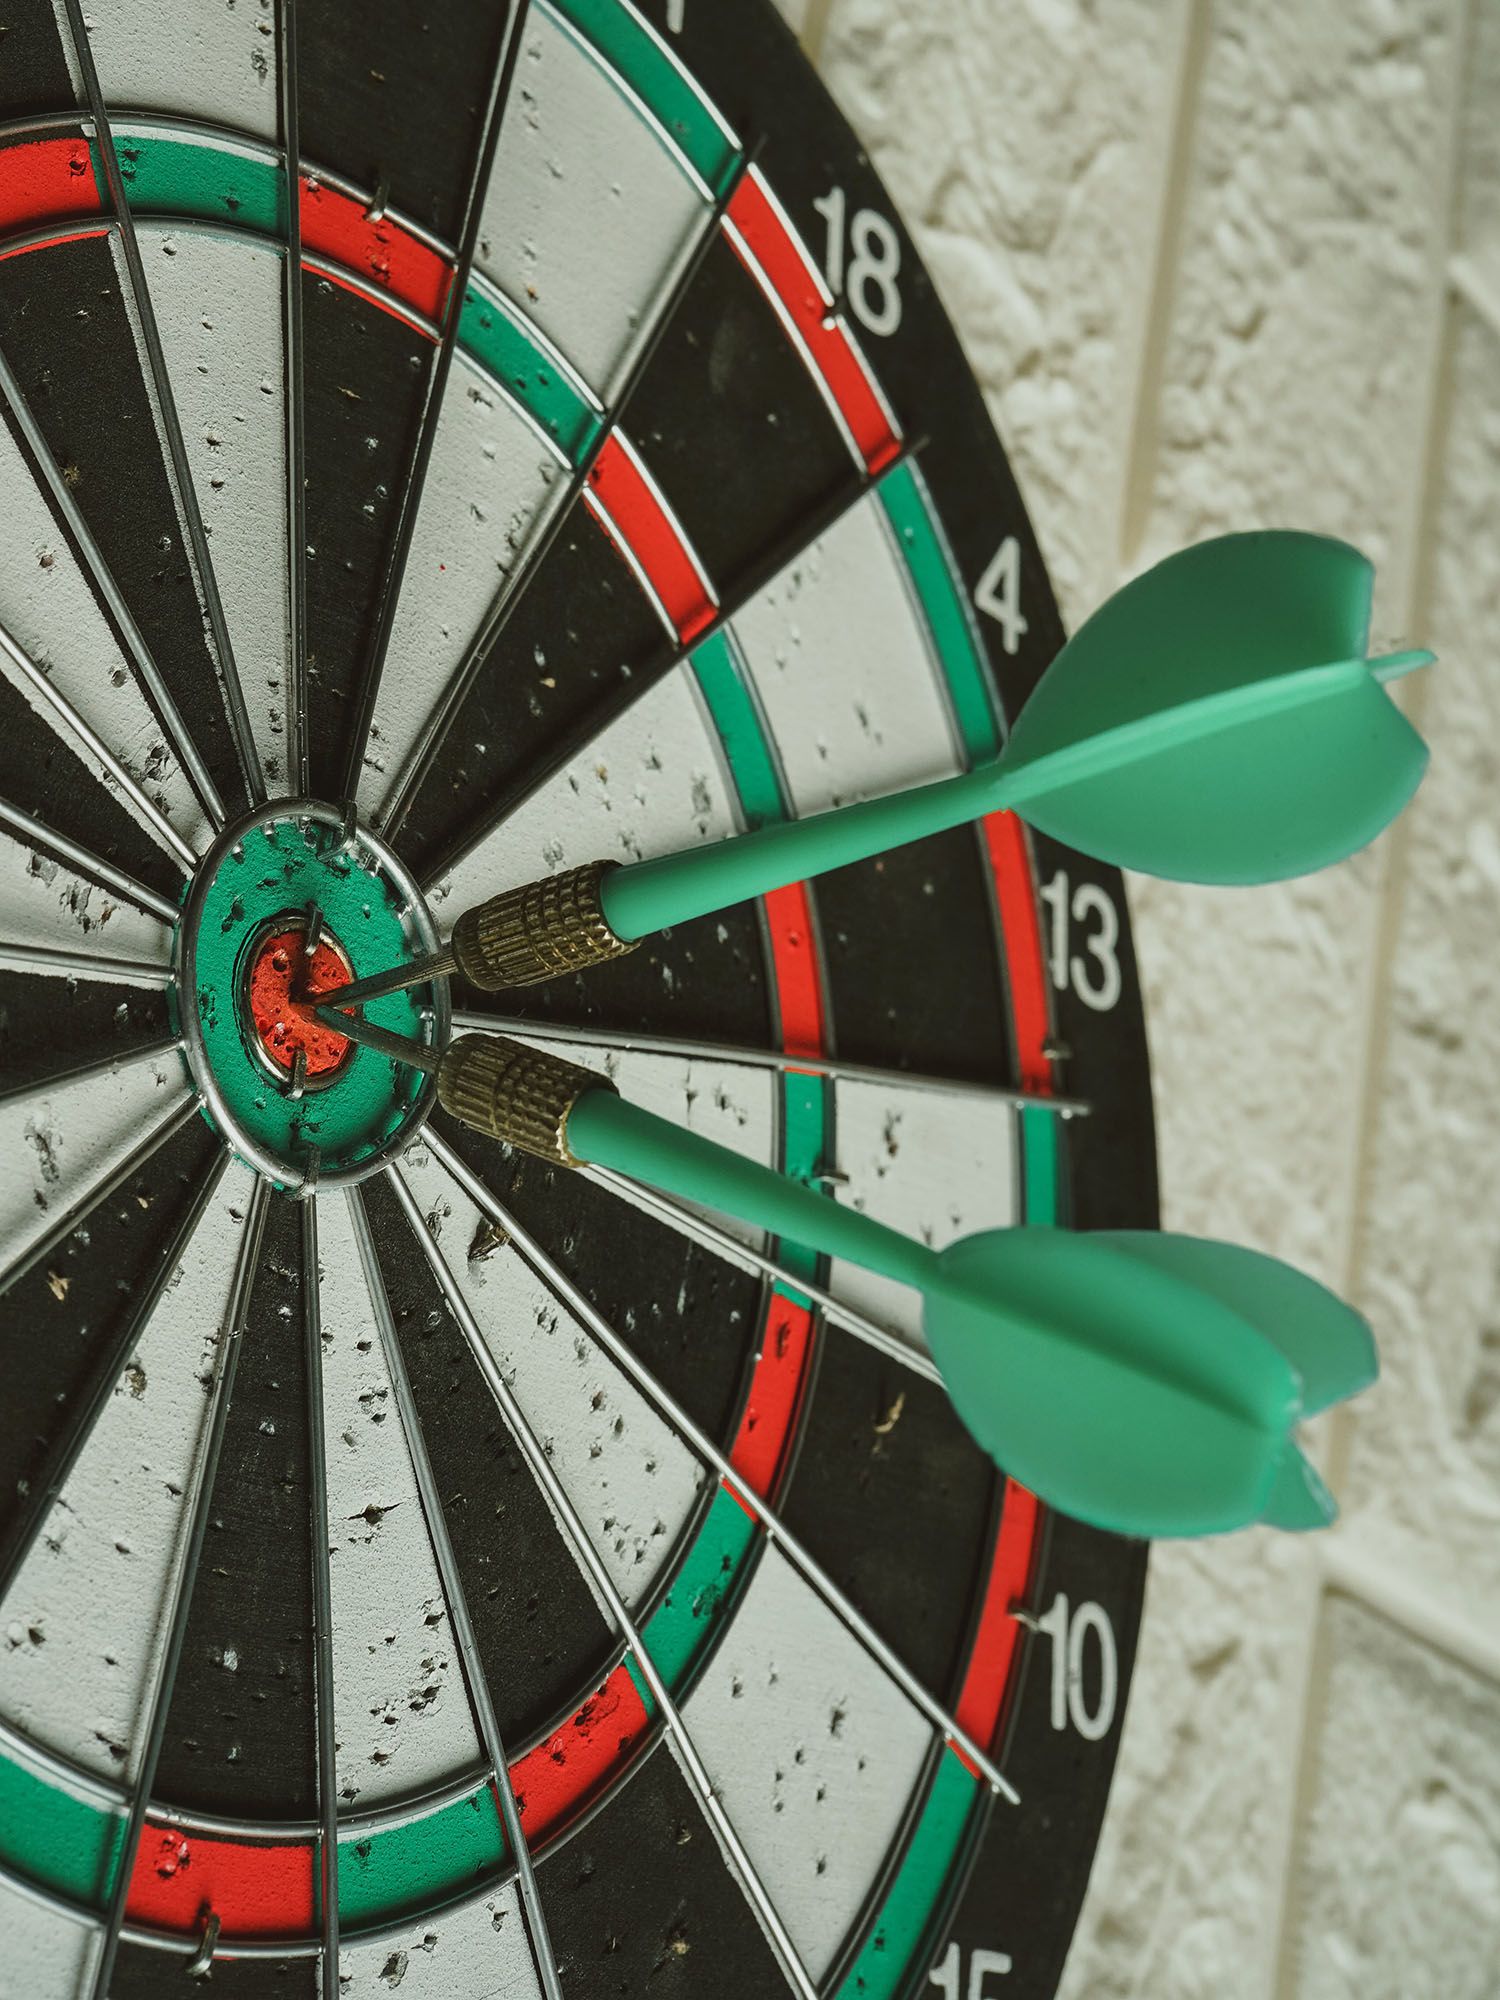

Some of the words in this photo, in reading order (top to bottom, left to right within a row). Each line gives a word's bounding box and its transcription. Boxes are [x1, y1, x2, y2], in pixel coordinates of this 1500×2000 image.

[813, 187, 902, 336] 18
[975, 537, 1027, 654] 4
[1041, 870, 1121, 1010] 13
[1039, 1592, 1118, 1740] 10
